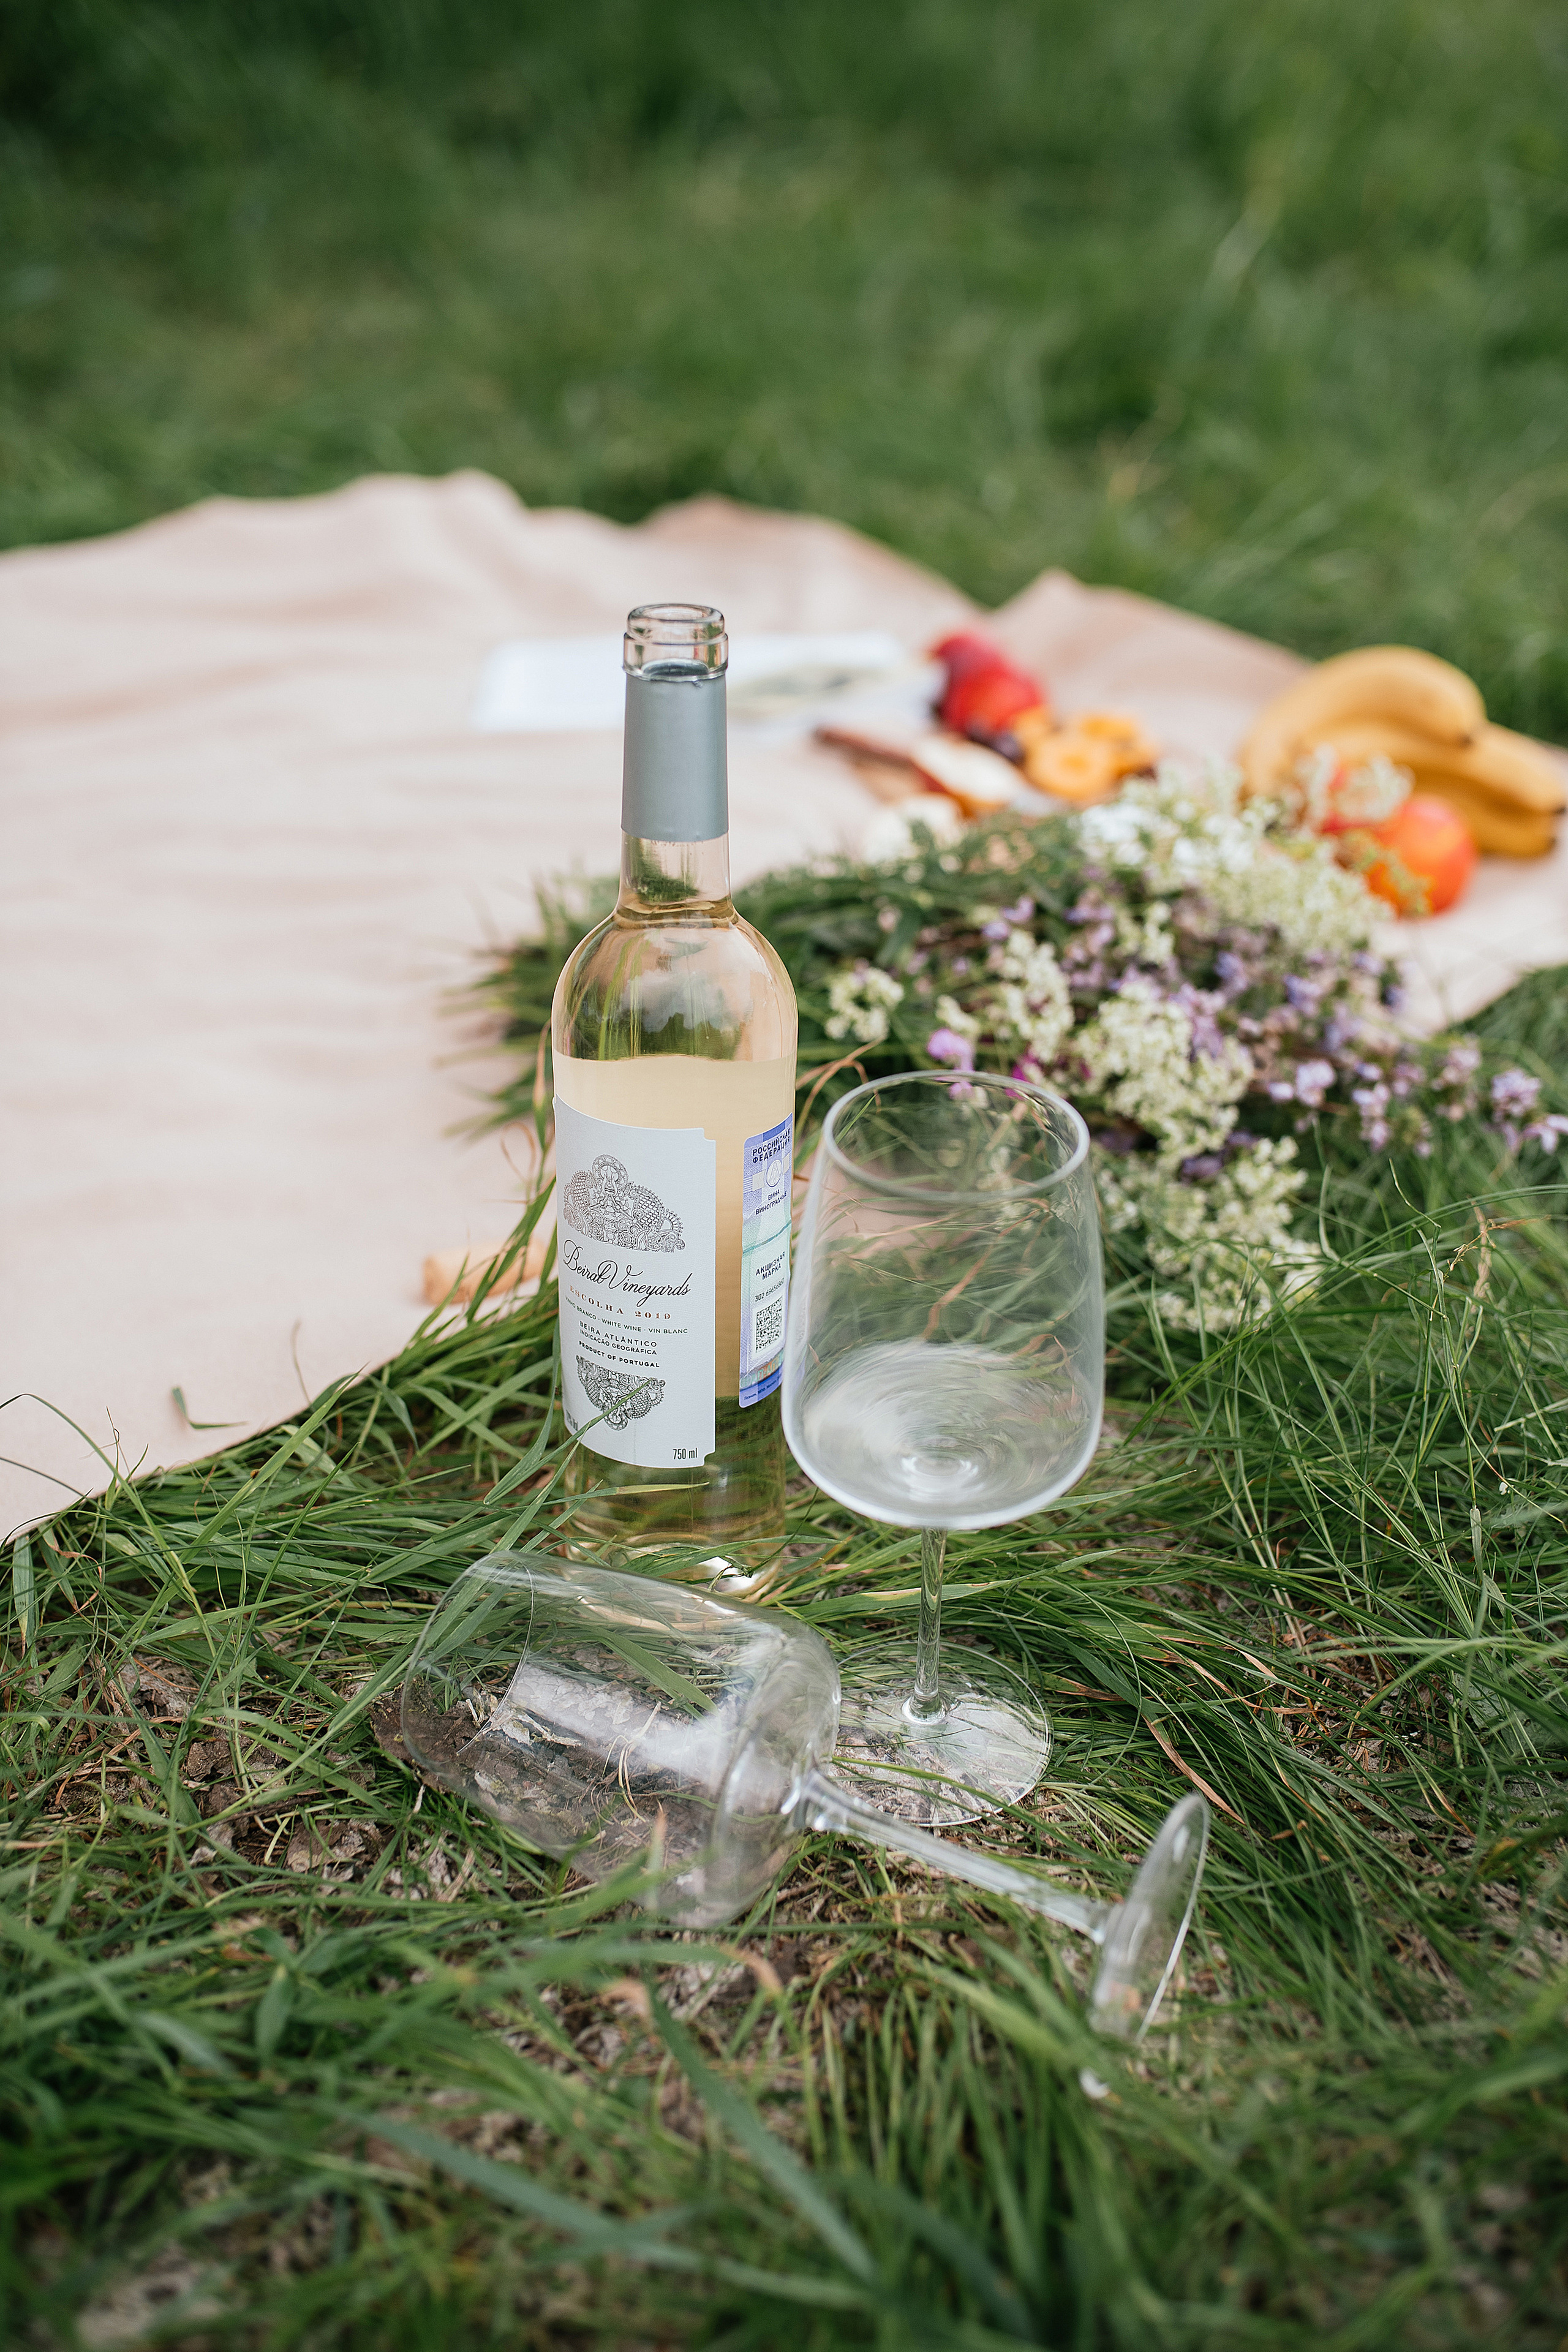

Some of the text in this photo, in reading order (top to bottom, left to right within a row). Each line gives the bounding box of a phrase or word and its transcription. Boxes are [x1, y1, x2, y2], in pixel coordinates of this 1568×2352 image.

[752, 1128, 790, 1156] РОССИЙСКАЯ
[752, 1136, 790, 1164] ФЕДЕРАЦИЯ
[767, 1189, 780, 1200] ВИНА
[563, 1239, 693, 1307] Beiral Vineyards
[755, 1251, 785, 1276] АКЦИЗНАЯ
[762, 1263, 781, 1280] МАРКА
[570, 1285, 671, 1320] ESCOLHA 2019
[755, 1292, 765, 1302] 302
[576, 1305, 597, 1320] BRANCO
[601, 1318, 622, 1329] WHITE
[579, 1321, 601, 1335] BEIRA
[579, 1329, 657, 1355] INDICAÇÃO GEOGRÁFICA
[579, 1340, 605, 1357] PRODUCT
[619, 1357, 660, 1368] PORTUGAL
[673, 1447, 698, 1460] 750 ml
